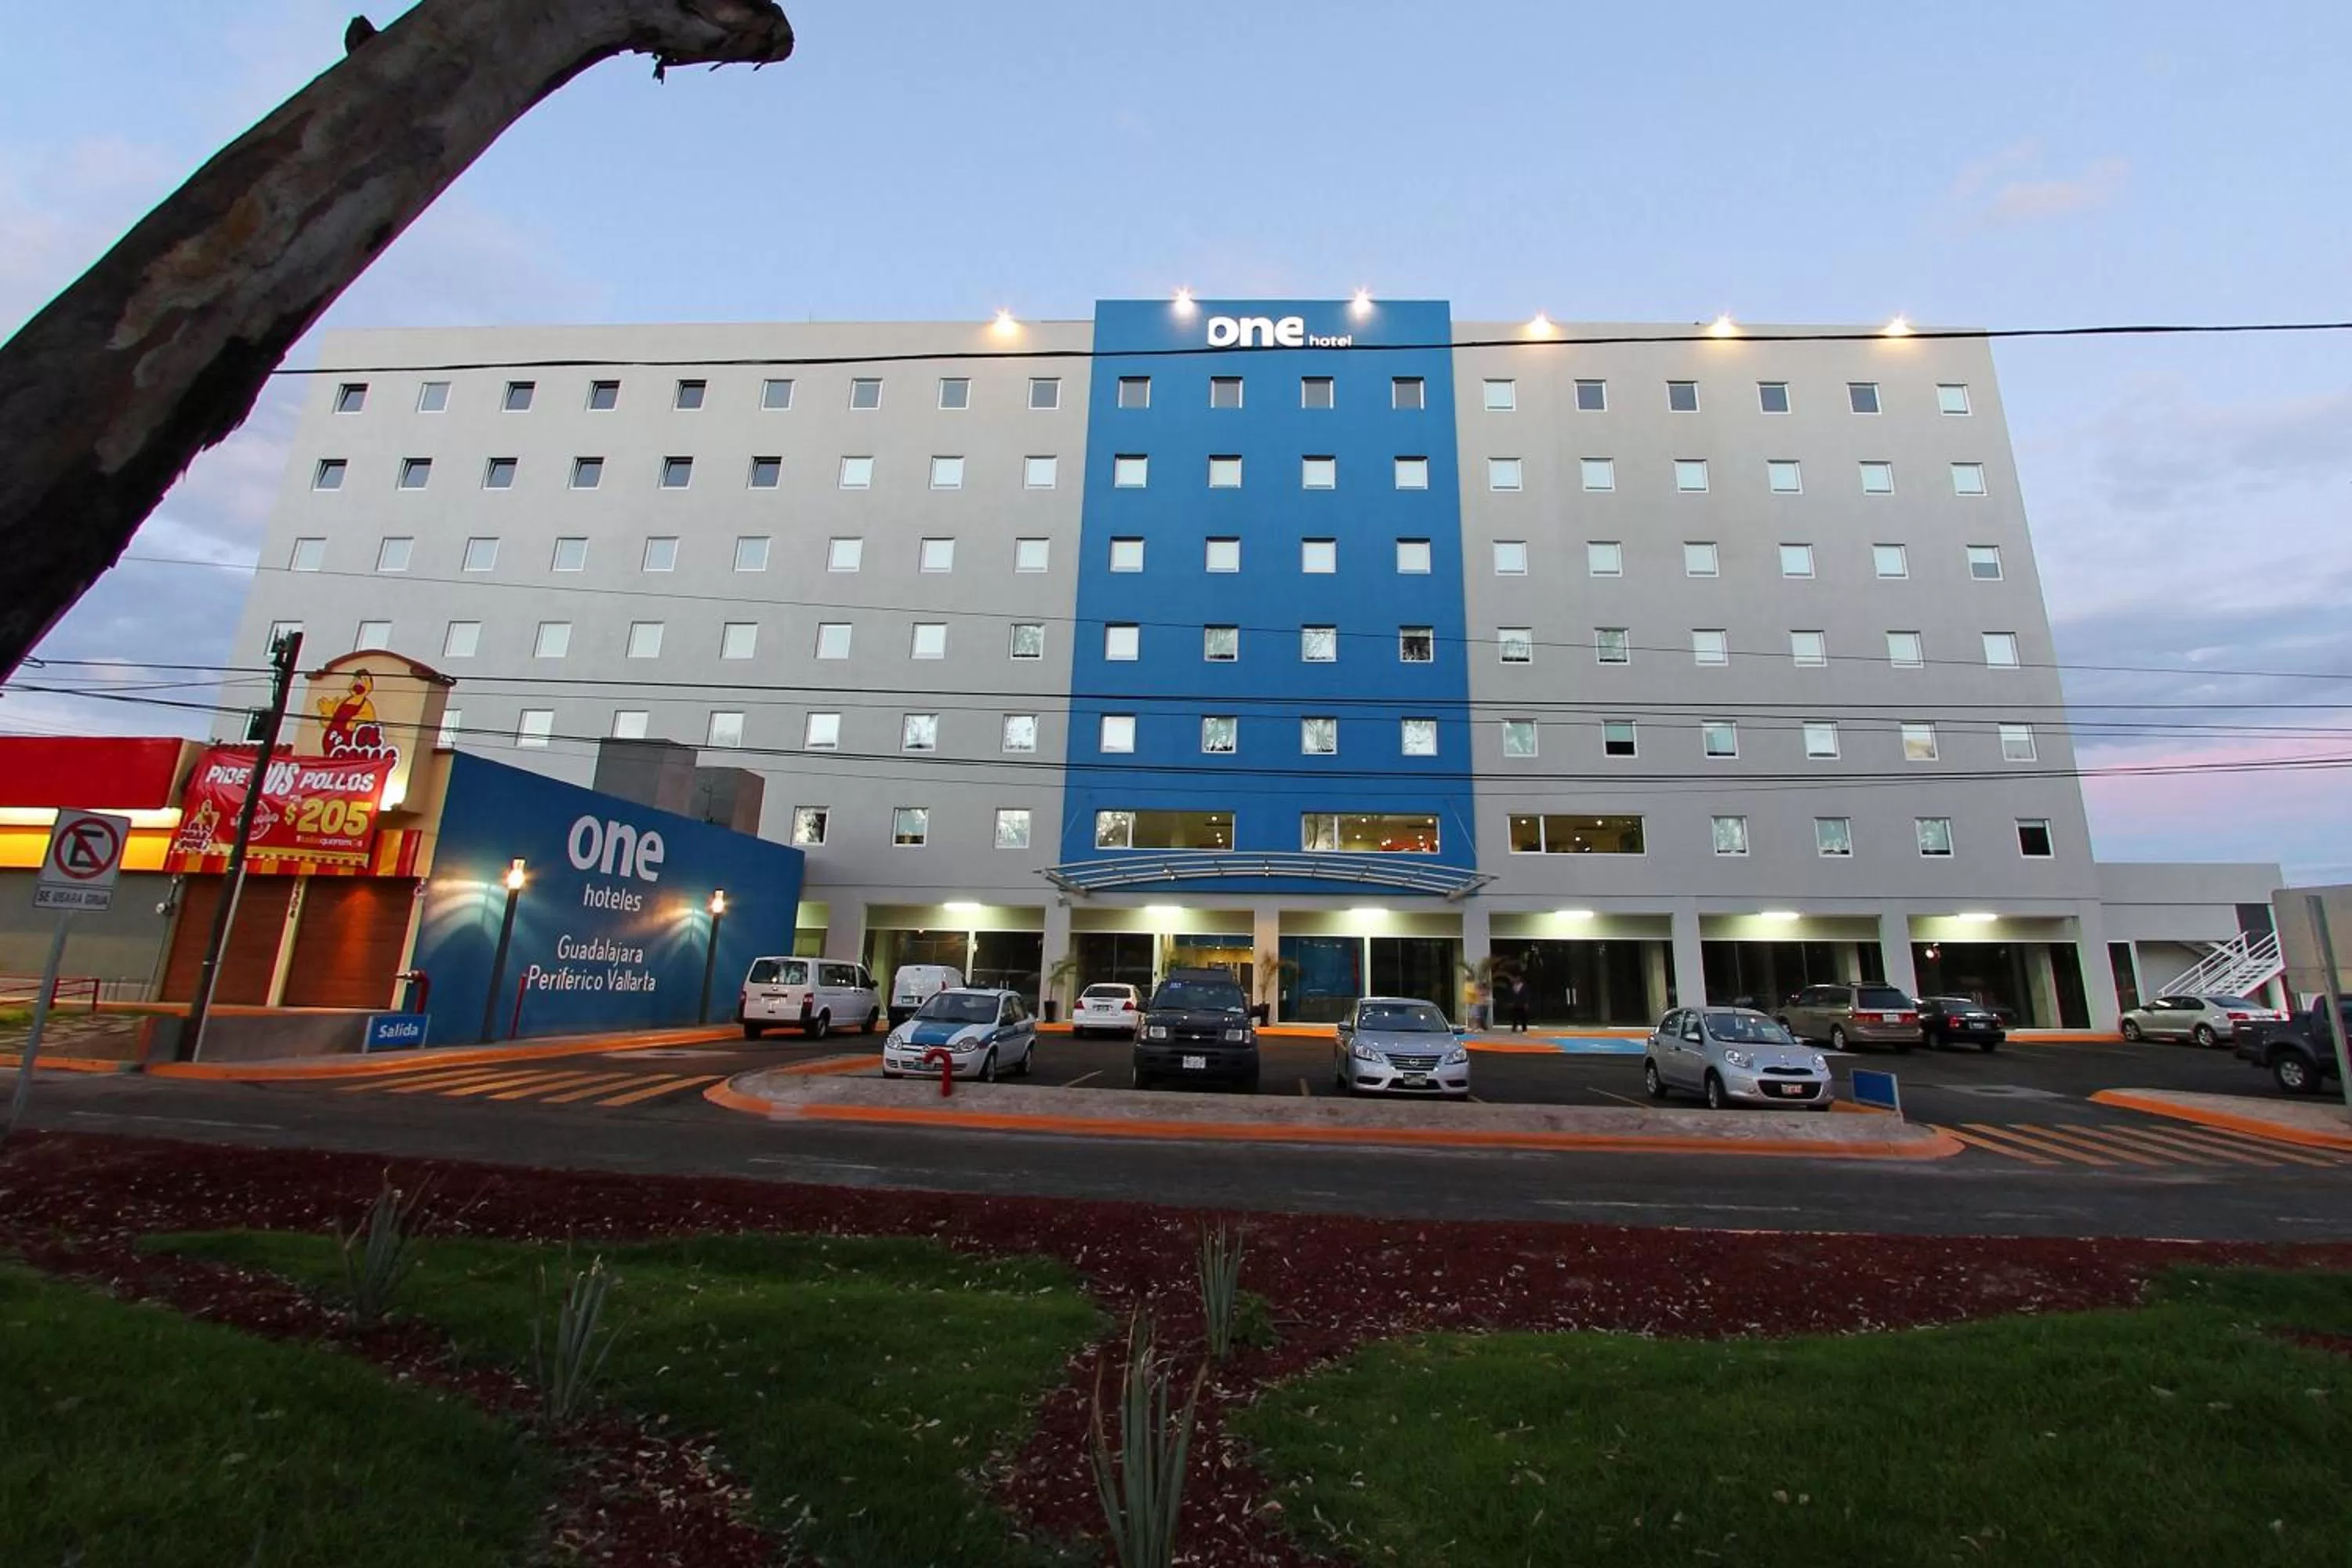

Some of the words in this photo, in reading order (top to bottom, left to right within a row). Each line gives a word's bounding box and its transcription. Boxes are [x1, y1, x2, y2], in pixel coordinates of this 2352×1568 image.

[1207, 316, 1305, 347] one
[1308, 334, 1352, 347] hotel
[247, 761, 300, 796] OS
[299, 771, 376, 793] POLLOS
[568, 815, 665, 882] one
[583, 883, 643, 912] hoteles
[557, 934, 644, 967] Guadalajara
[526, 964, 603, 991] Periférico
[607, 967, 656, 992] Vallarta
[378, 1022, 419, 1039] Salida
